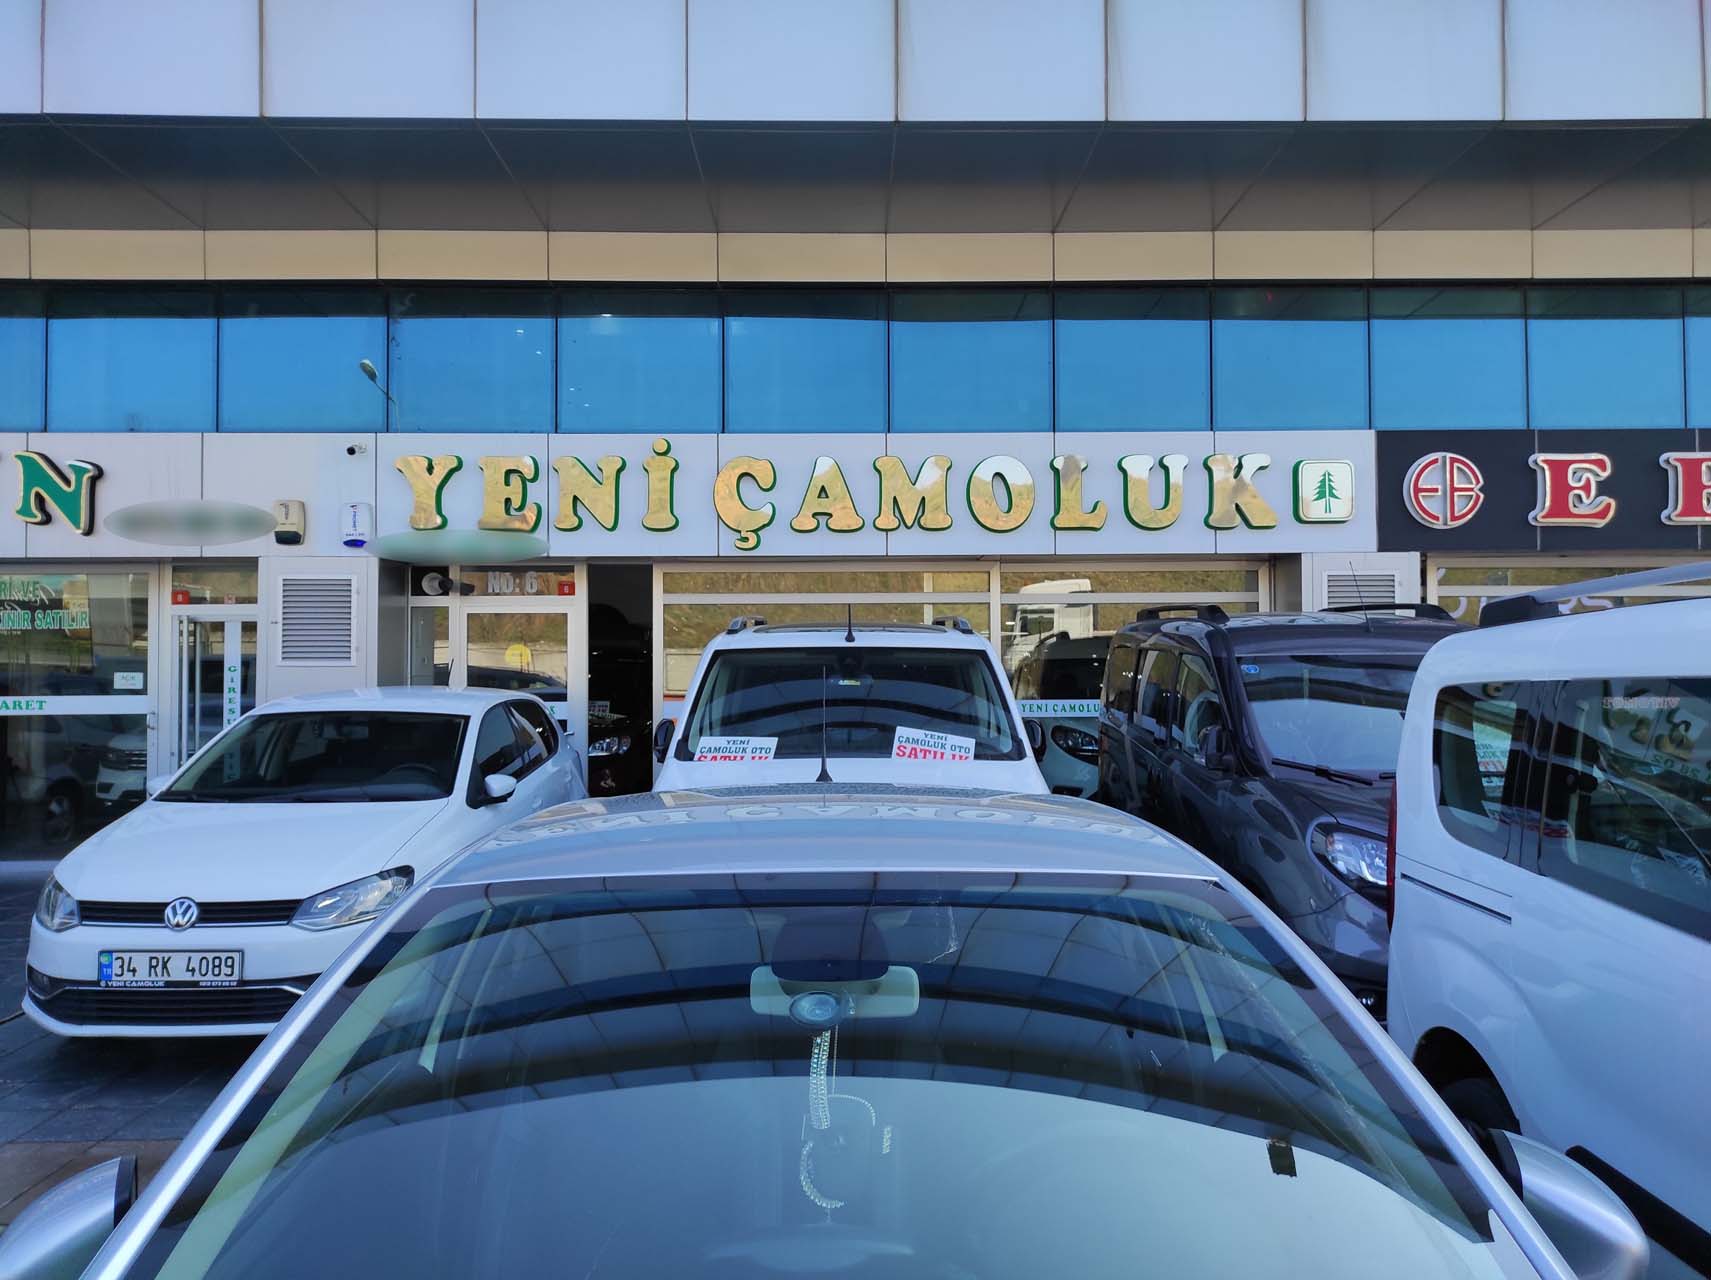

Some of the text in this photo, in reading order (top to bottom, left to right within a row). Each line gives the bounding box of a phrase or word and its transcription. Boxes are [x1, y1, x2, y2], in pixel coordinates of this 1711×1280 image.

[395, 438, 1279, 550] YENİ ÇAMOLUK
[525, 571, 538, 593] 6
[0, 609, 31, 630] INIR
[950, 744, 971, 754] OTO
[114, 956, 235, 977] 34 RK 4089
